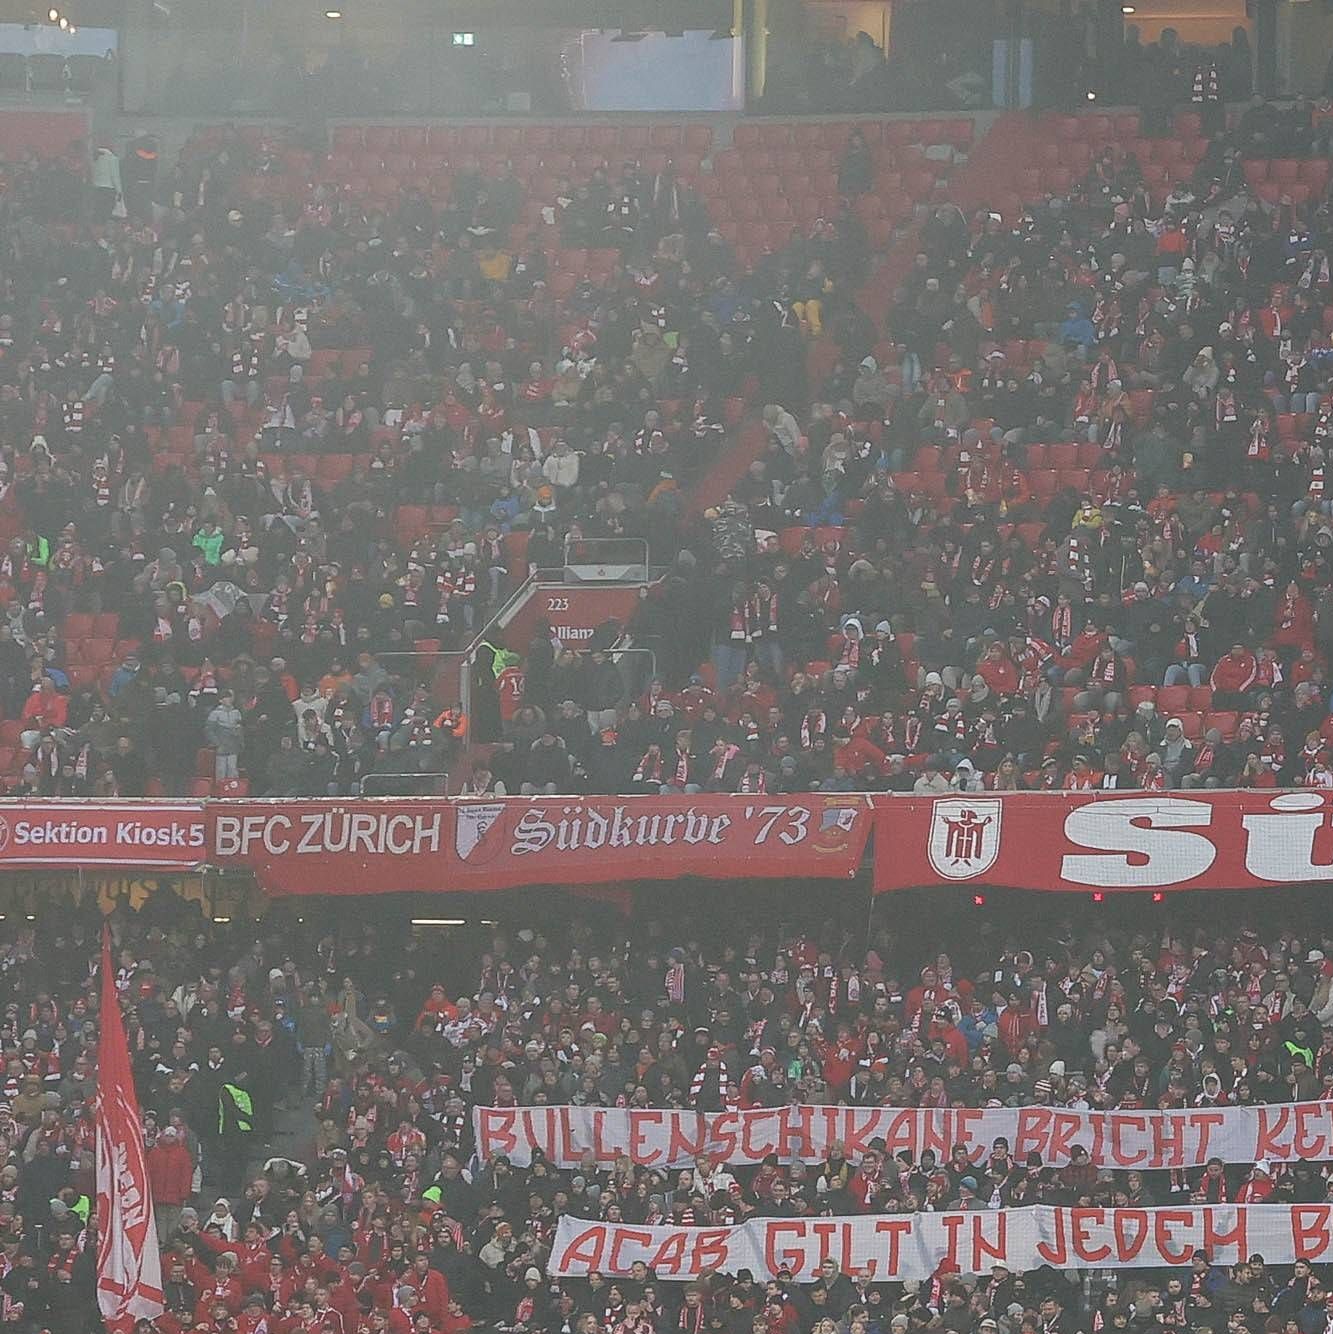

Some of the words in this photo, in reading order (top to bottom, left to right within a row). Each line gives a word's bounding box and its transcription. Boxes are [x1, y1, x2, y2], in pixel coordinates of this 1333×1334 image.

[547, 598, 569, 611] 223
[15, 822, 107, 845] Sektion
[116, 822, 186, 846] Kiosk
[215, 815, 292, 856] BFC
[296, 811, 440, 855] ZÜRICH
[511, 806, 732, 855] Südkurve
[745, 806, 812, 847] '73
[479, 1106, 985, 1167] BULLENSCHIKANE
[1015, 1104, 1224, 1168] BRICHT
[558, 1225, 729, 1274] ACAB
[764, 1220, 914, 1277] GILT
[941, 1214, 1006, 1263] IN
[1037, 1206, 1247, 1264] JEDEM
